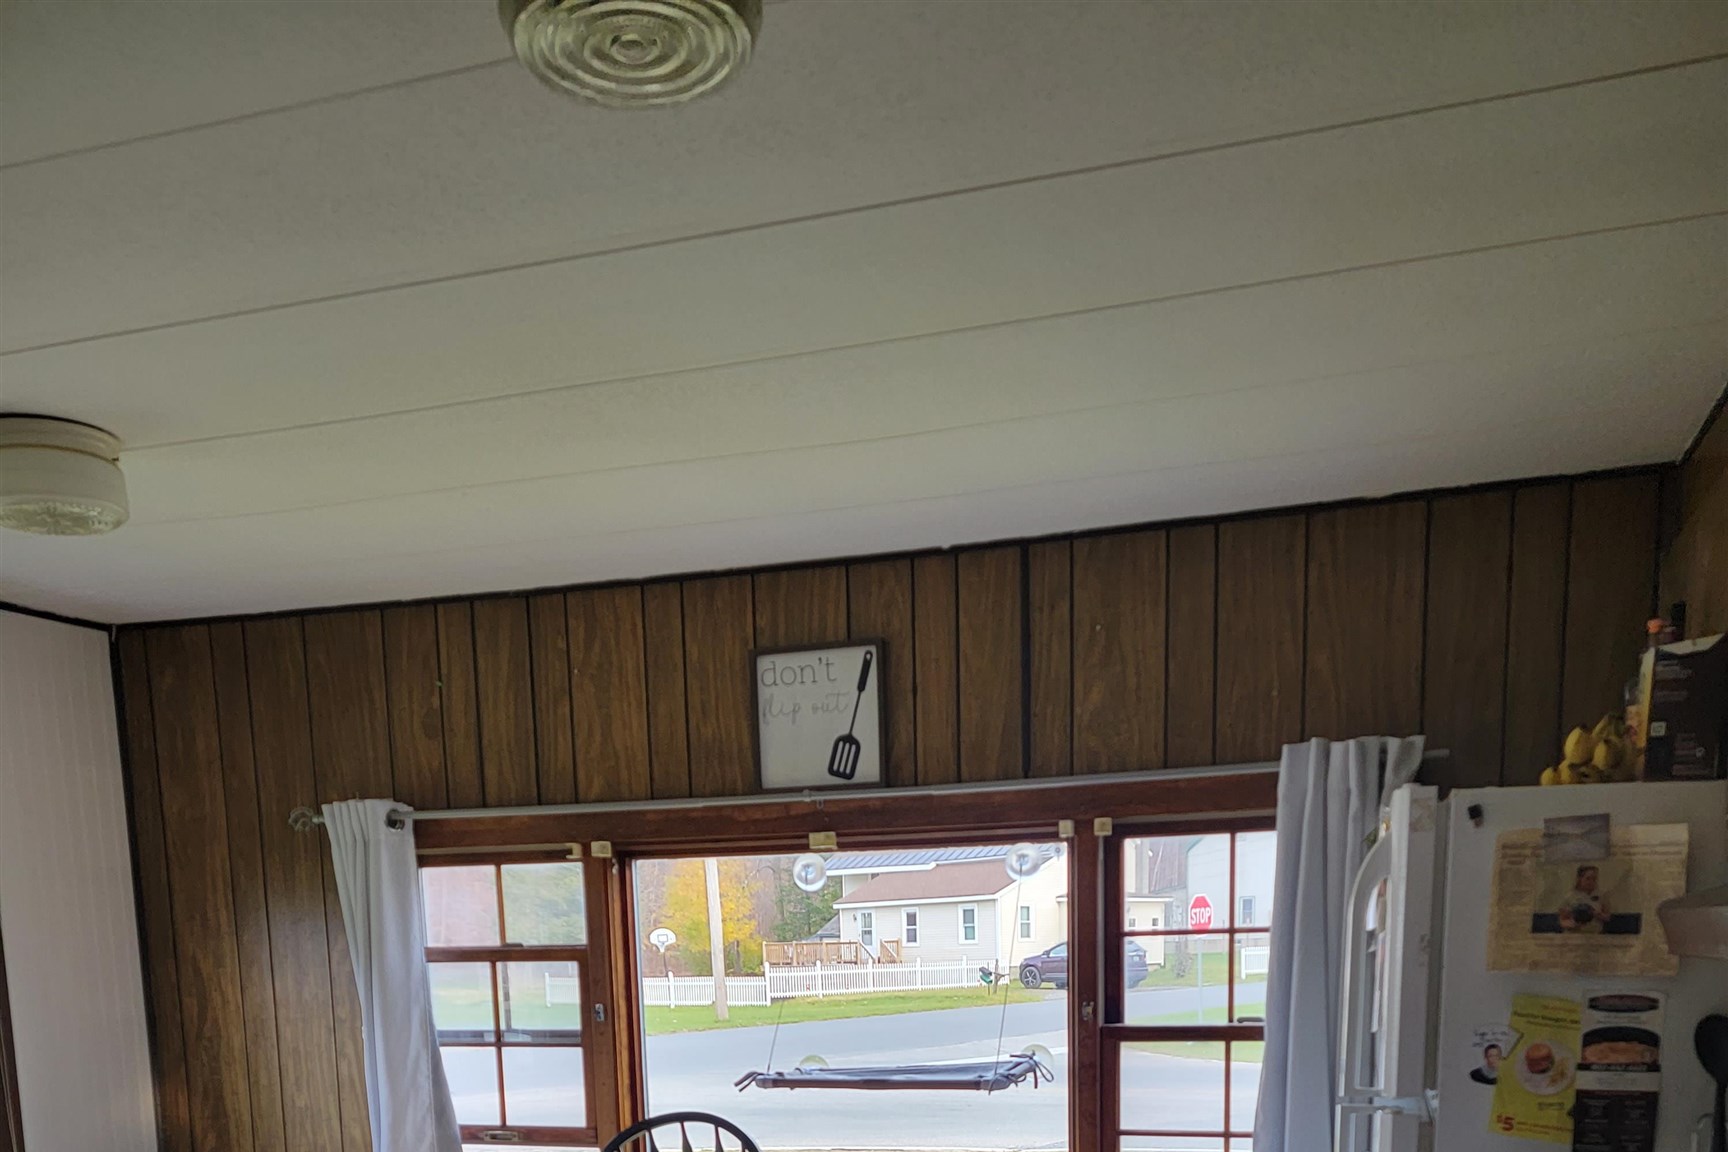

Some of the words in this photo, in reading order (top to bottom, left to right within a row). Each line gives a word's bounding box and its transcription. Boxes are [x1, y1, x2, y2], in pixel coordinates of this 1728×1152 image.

[761, 657, 837, 687] don't
[762, 692, 802, 725] flip
[811, 692, 850, 716] out
[1191, 907, 1211, 925] STOP
